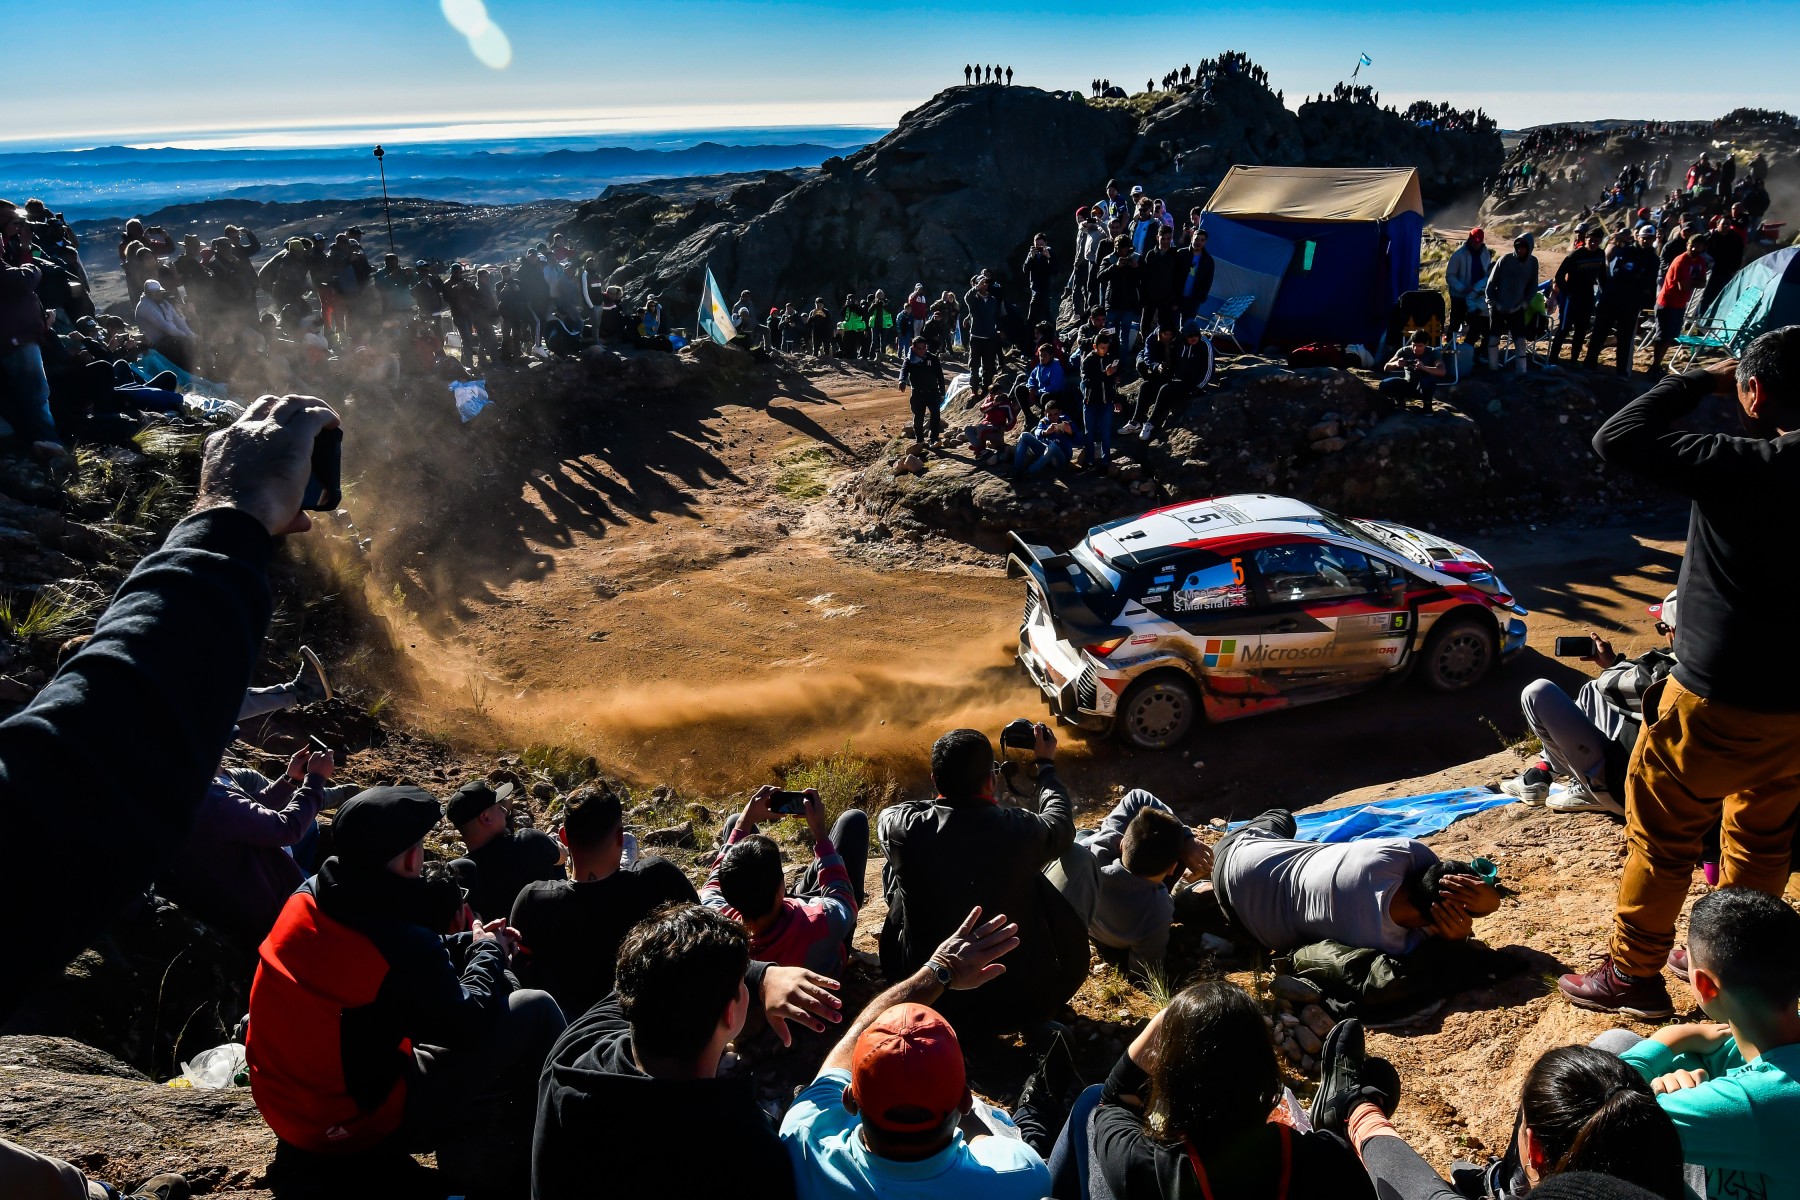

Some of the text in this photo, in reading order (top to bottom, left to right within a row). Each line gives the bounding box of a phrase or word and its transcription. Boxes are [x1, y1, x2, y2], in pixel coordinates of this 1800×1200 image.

[1187, 513, 1221, 524] 5
[1231, 557, 1245, 585] 5
[1174, 598, 1230, 612] S.Marshall
[1394, 616, 1403, 627] 5
[1241, 640, 1338, 662] Microsoft
